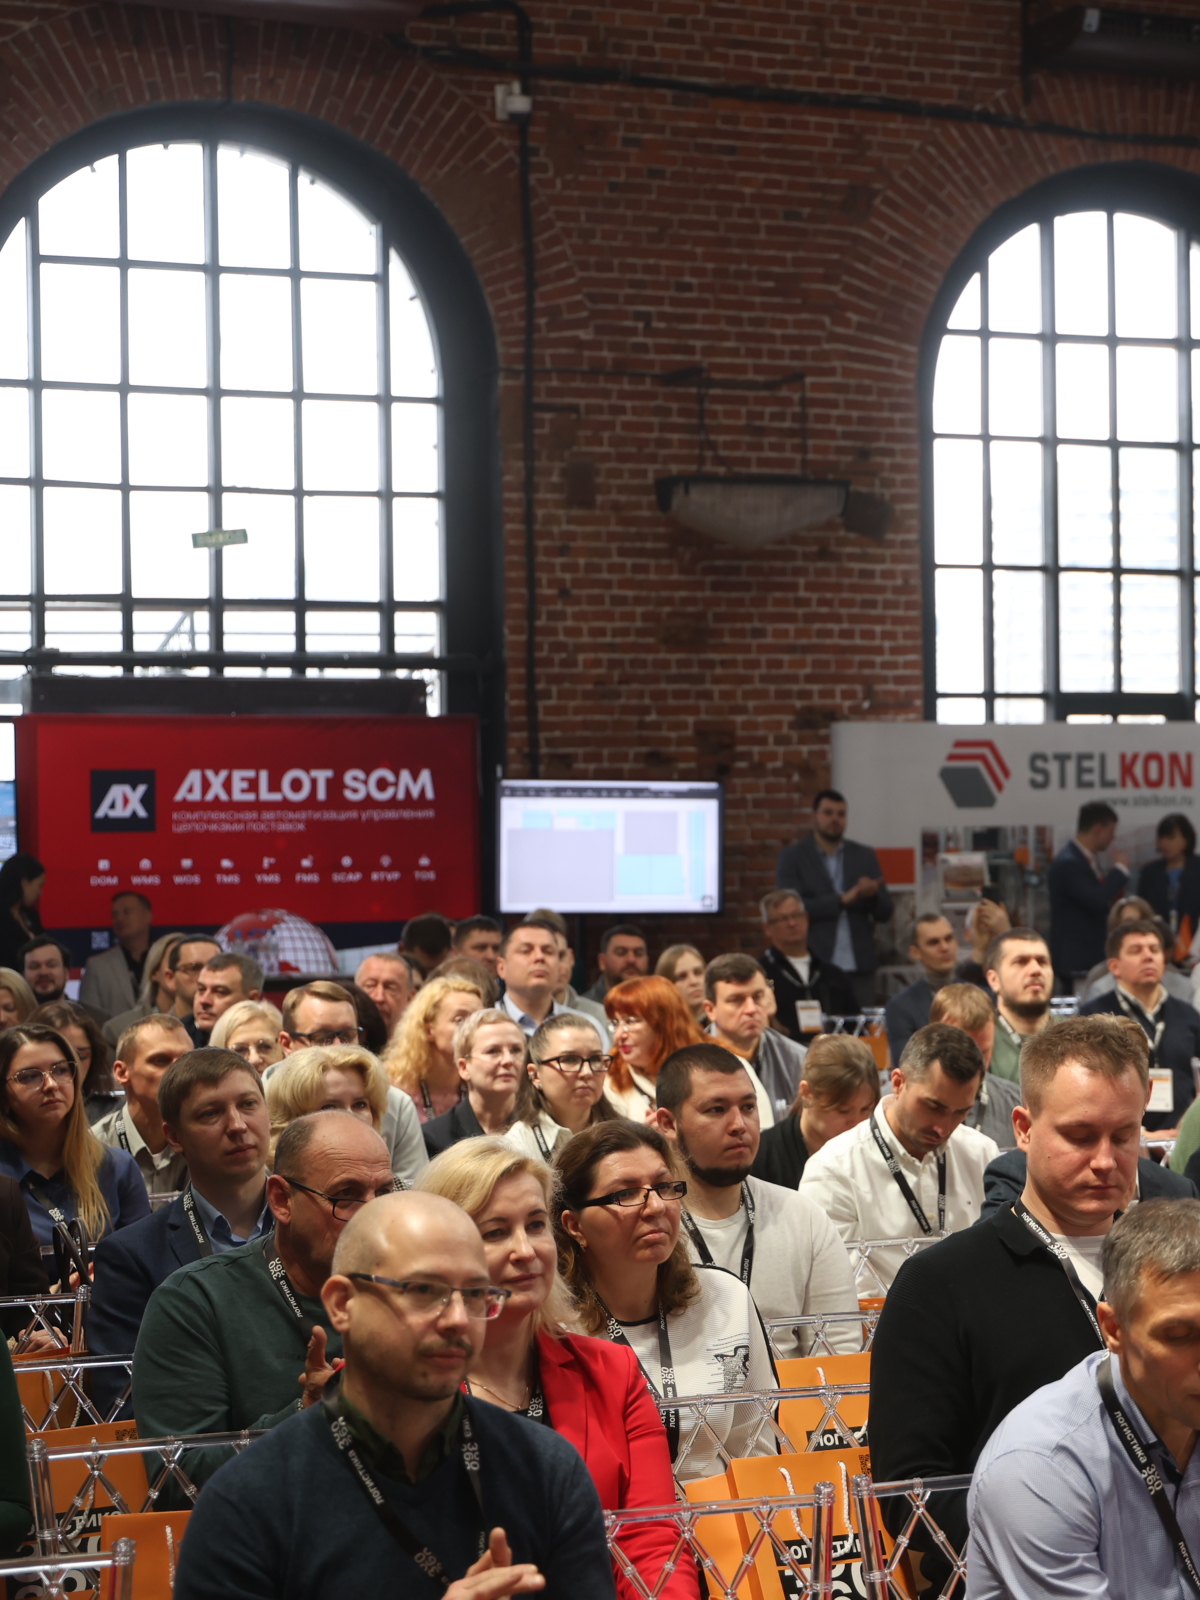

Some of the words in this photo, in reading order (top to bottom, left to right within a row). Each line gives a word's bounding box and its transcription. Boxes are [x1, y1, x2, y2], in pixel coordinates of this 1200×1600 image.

[174, 769, 333, 801] AXELOT
[343, 768, 435, 800] SCM
[1028, 752, 1194, 789] STELKON
[1114, 1410, 1147, 1464] логистика
